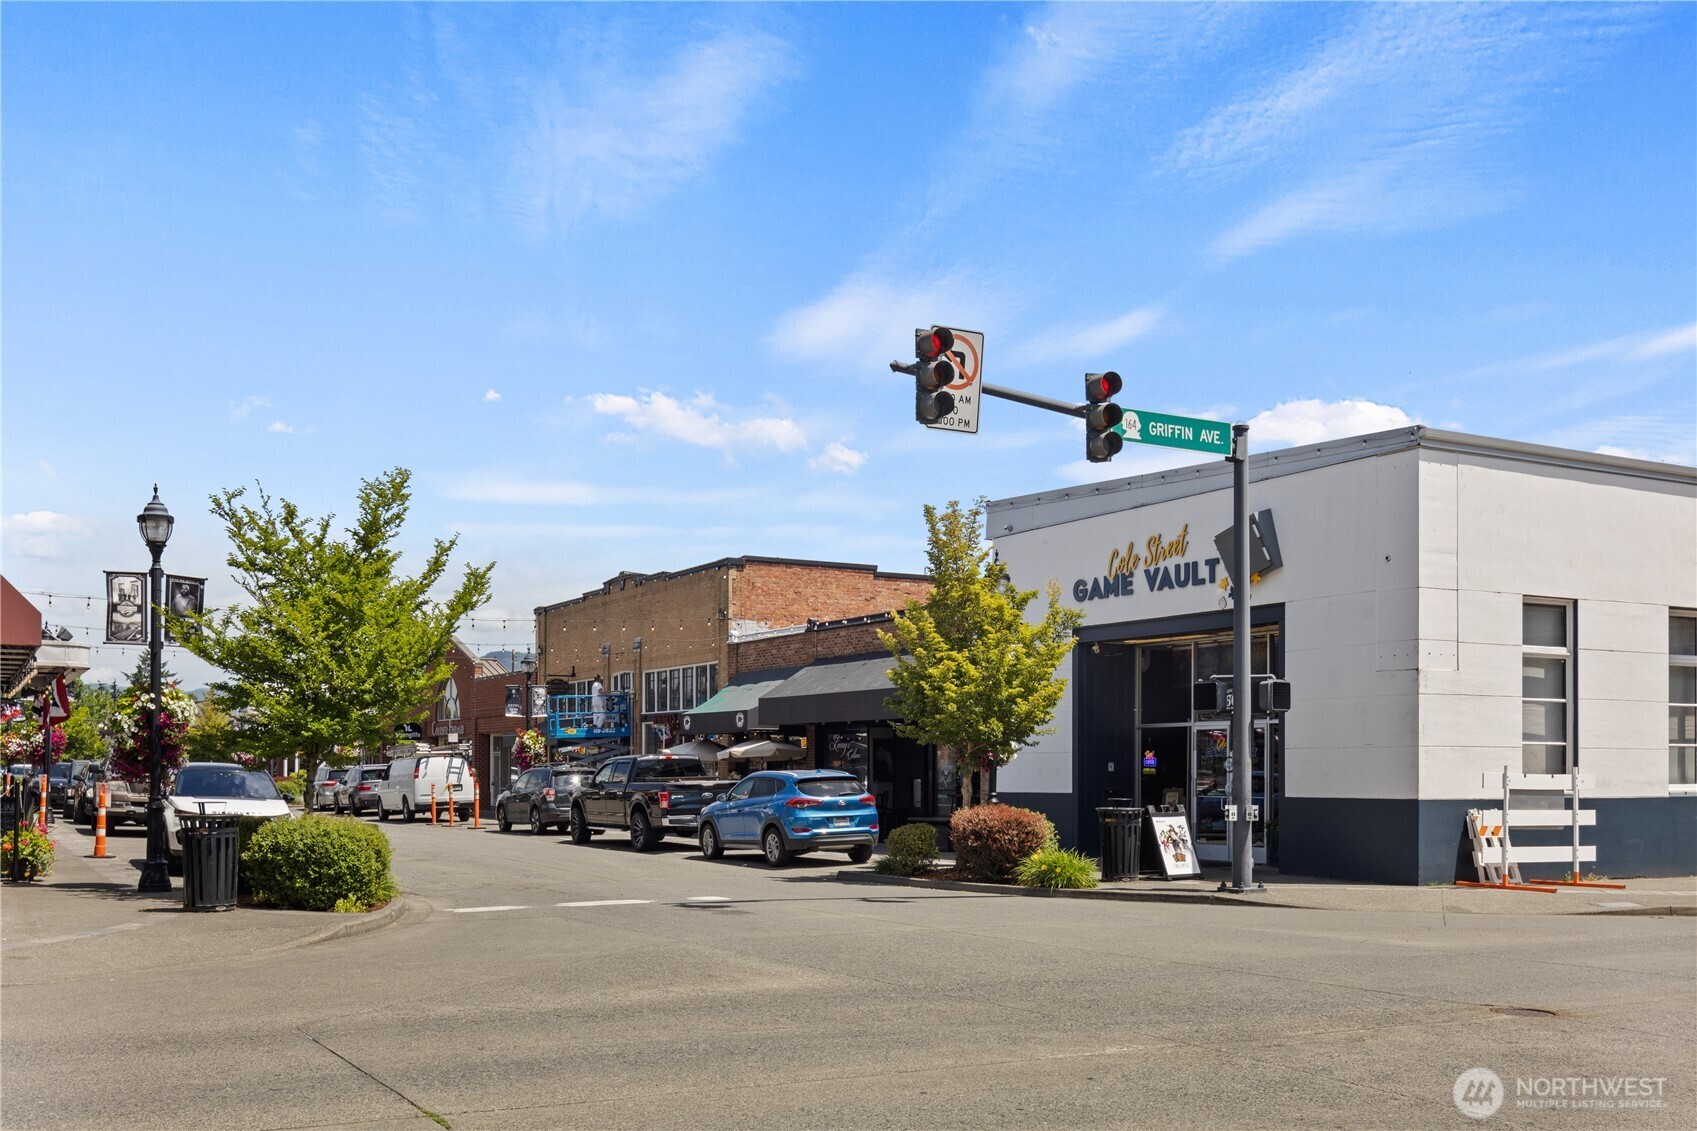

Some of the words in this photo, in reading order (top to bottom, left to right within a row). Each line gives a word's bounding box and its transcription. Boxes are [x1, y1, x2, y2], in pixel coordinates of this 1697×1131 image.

[958, 395, 971, 405] AM
[953, 405, 959, 415] O
[957, 417, 970, 429] PM
[1125, 418, 1138, 431] 164
[1148, 422, 1193, 441] GRIFFIN
[1199, 429, 1224, 445] AVE.
[1107, 541, 1141, 580] Cole
[1143, 523, 1189, 568] Street
[1073, 571, 1134, 603] GAME
[1143, 557, 1220, 592] VAULT
